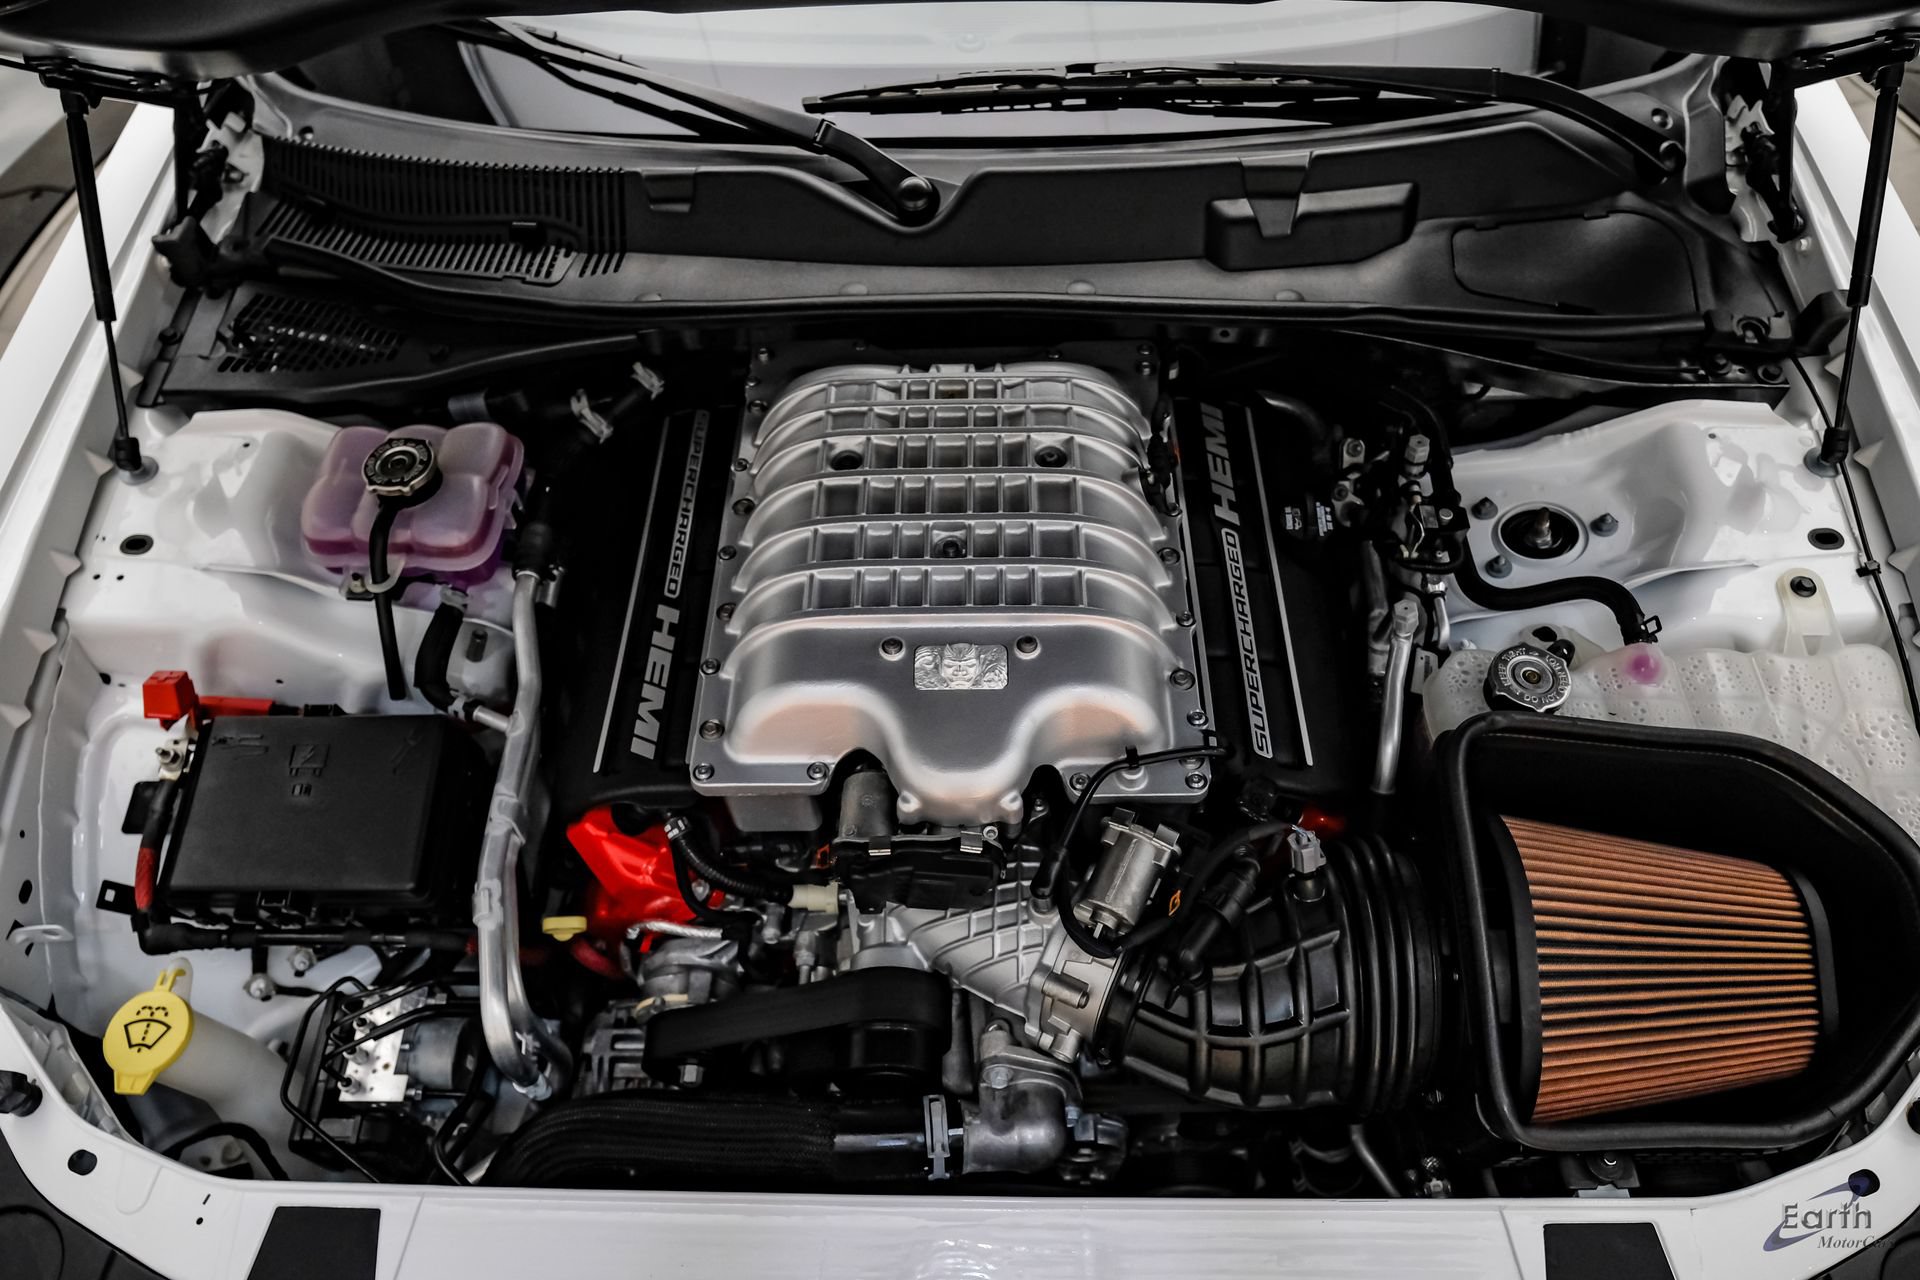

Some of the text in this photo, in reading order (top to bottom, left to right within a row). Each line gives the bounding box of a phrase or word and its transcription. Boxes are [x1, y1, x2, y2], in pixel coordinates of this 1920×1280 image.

[630, 410, 709, 760] SUPERCHARGED HEMI
[1200, 402, 1272, 757] SUPERCHARGED HEMI
[1498, 663, 1511, 687] KEEP
[1523, 694, 1538, 703] DO
[1541, 691, 1560, 704] NOT
[1557, 671, 1570, 693] OPEN
